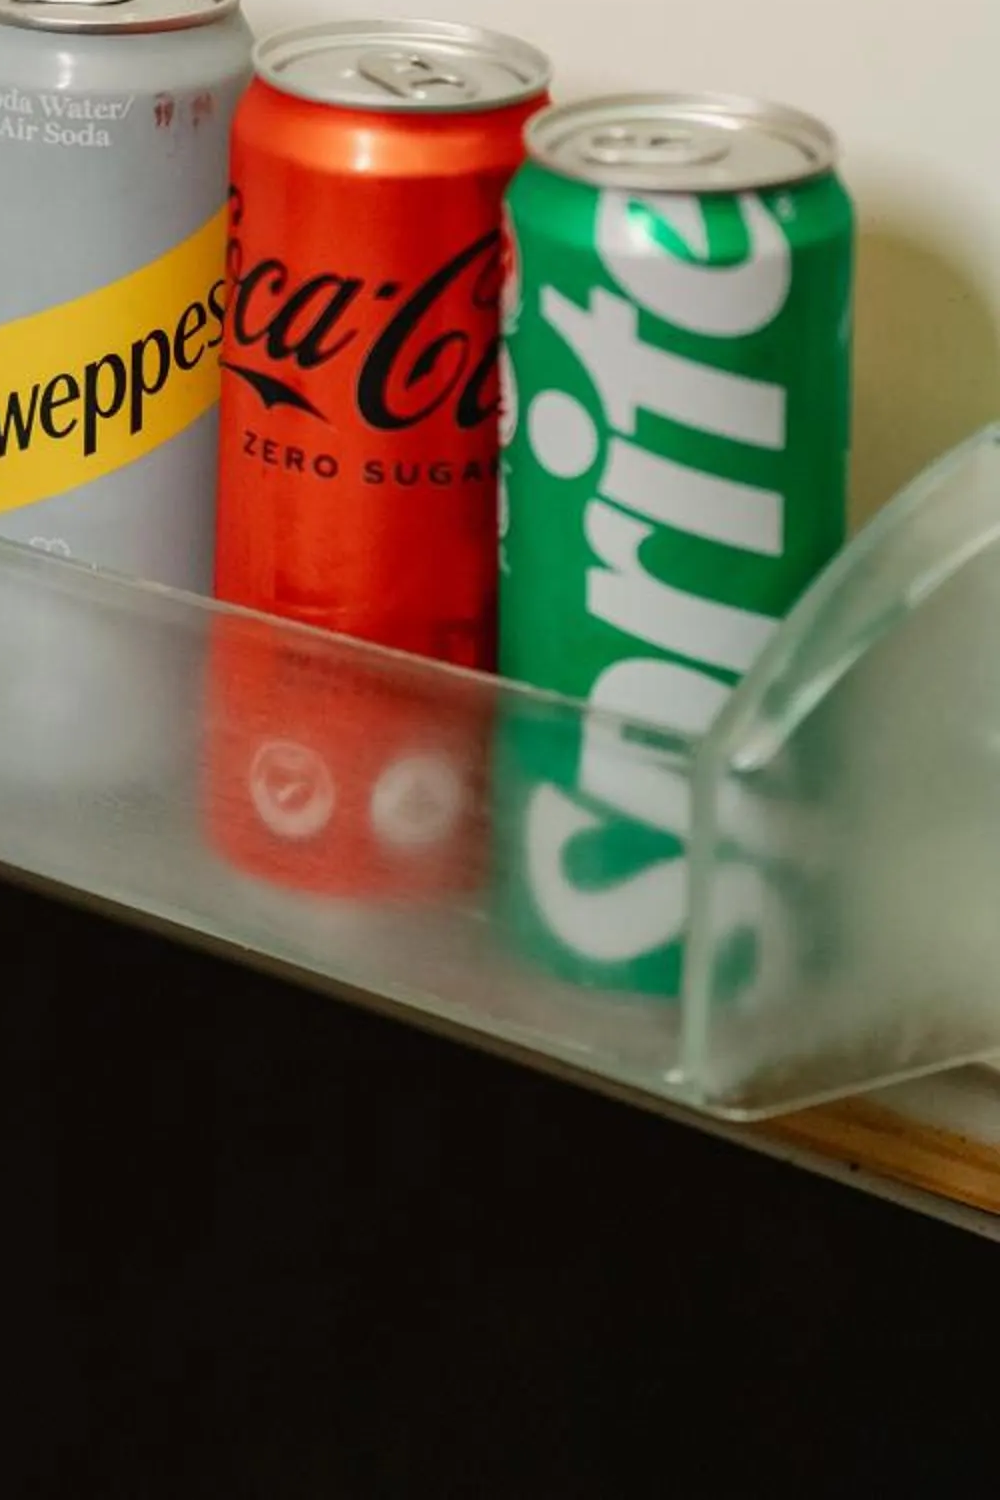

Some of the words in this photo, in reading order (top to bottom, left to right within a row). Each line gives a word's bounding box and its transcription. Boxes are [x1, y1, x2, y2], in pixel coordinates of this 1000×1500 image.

[40, 94, 135, 120] Water/
[43, 124, 111, 147] Soda
[242, 429, 338, 479] ZERO
